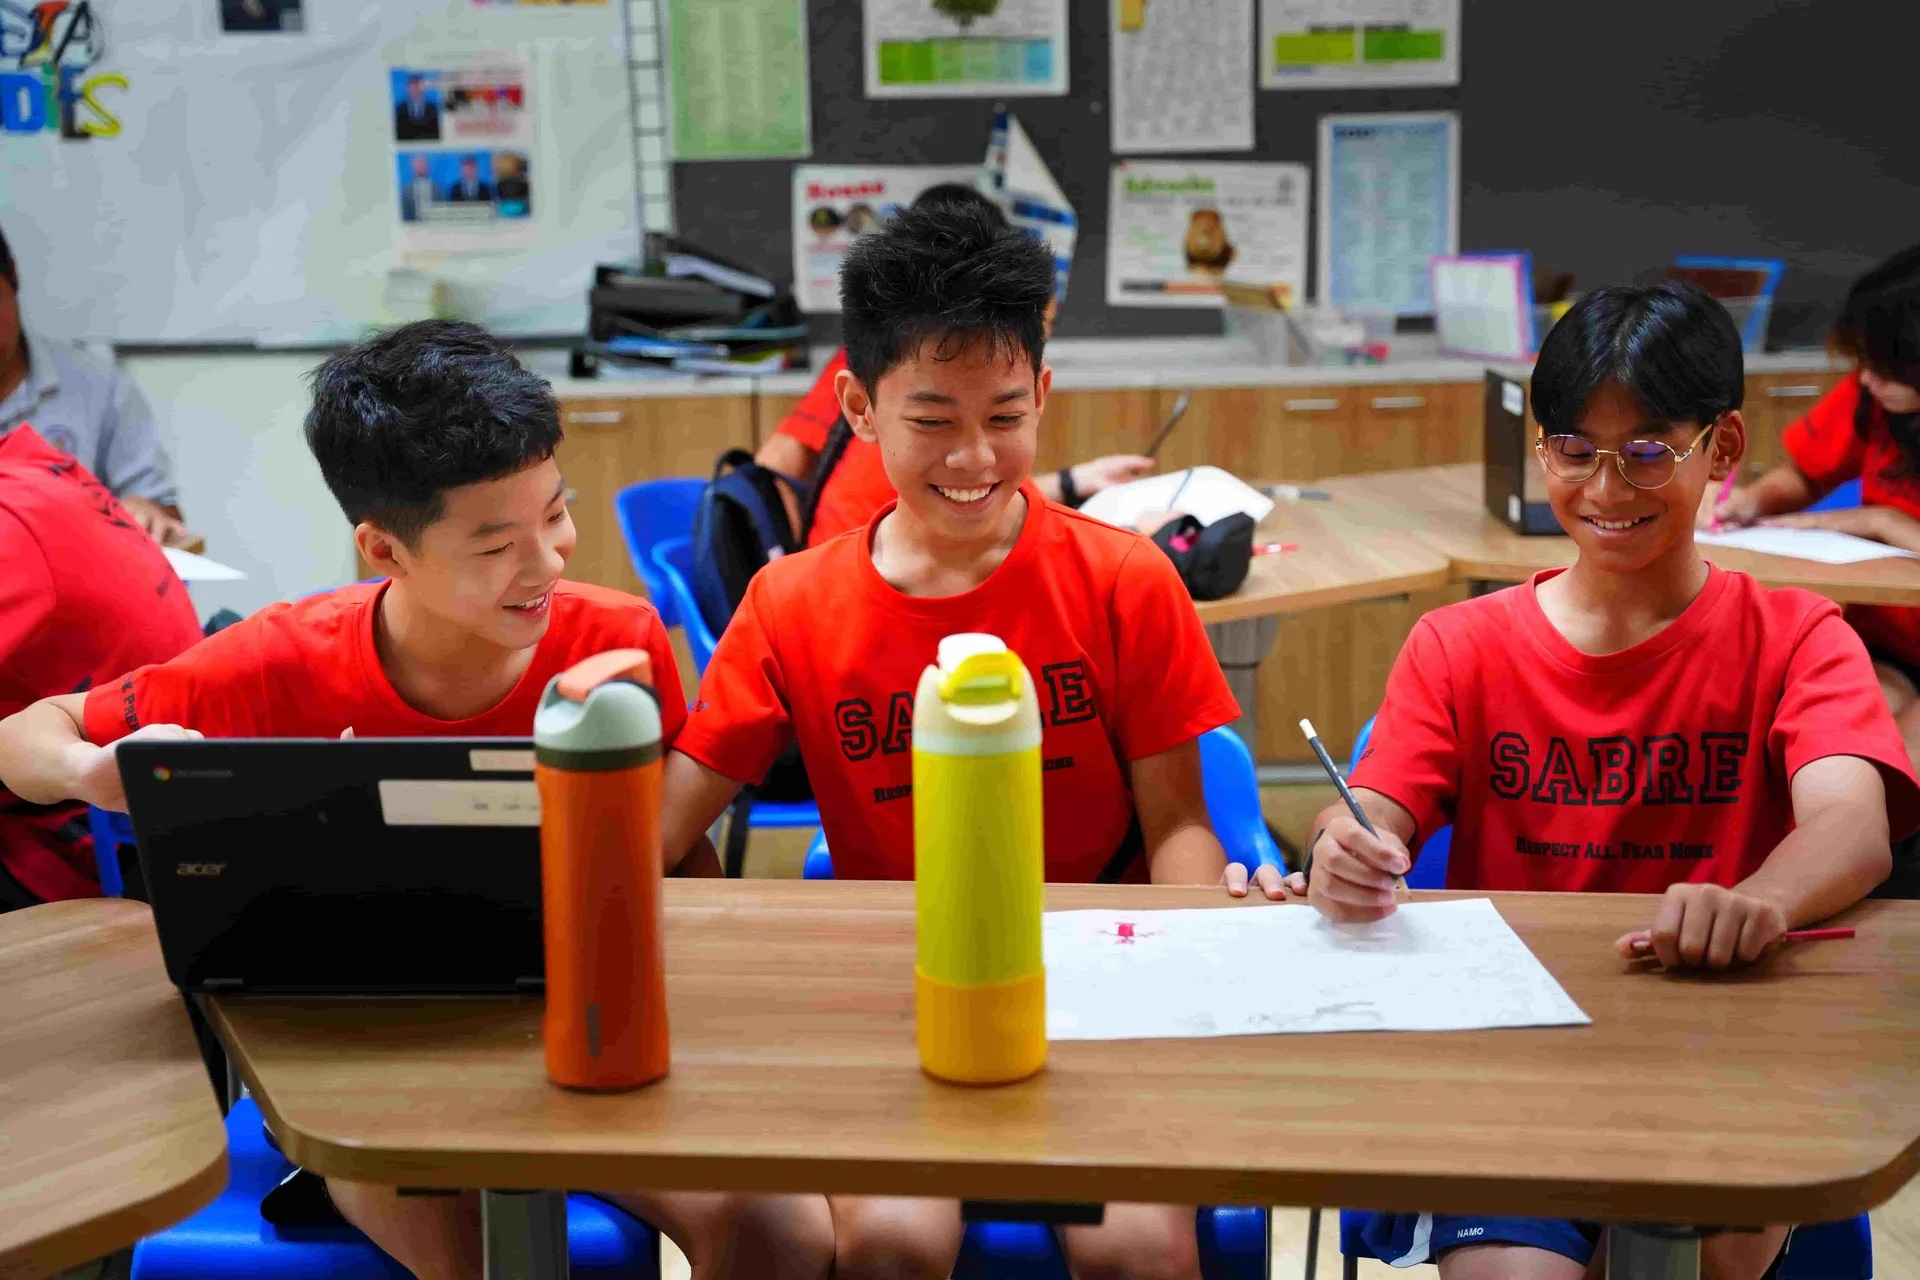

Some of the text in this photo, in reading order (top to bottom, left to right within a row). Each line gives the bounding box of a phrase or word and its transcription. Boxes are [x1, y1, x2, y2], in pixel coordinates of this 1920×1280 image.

[834, 660, 1097, 762] SAE
[1490, 731, 1749, 806] SABRE
[1516, 836, 1580, 857] RESPECT
[1621, 842, 1665, 860] FEAR
[1669, 842, 1715, 859] NONE
[176, 863, 227, 876] acer
[1457, 1227, 1484, 1238] NAMO
